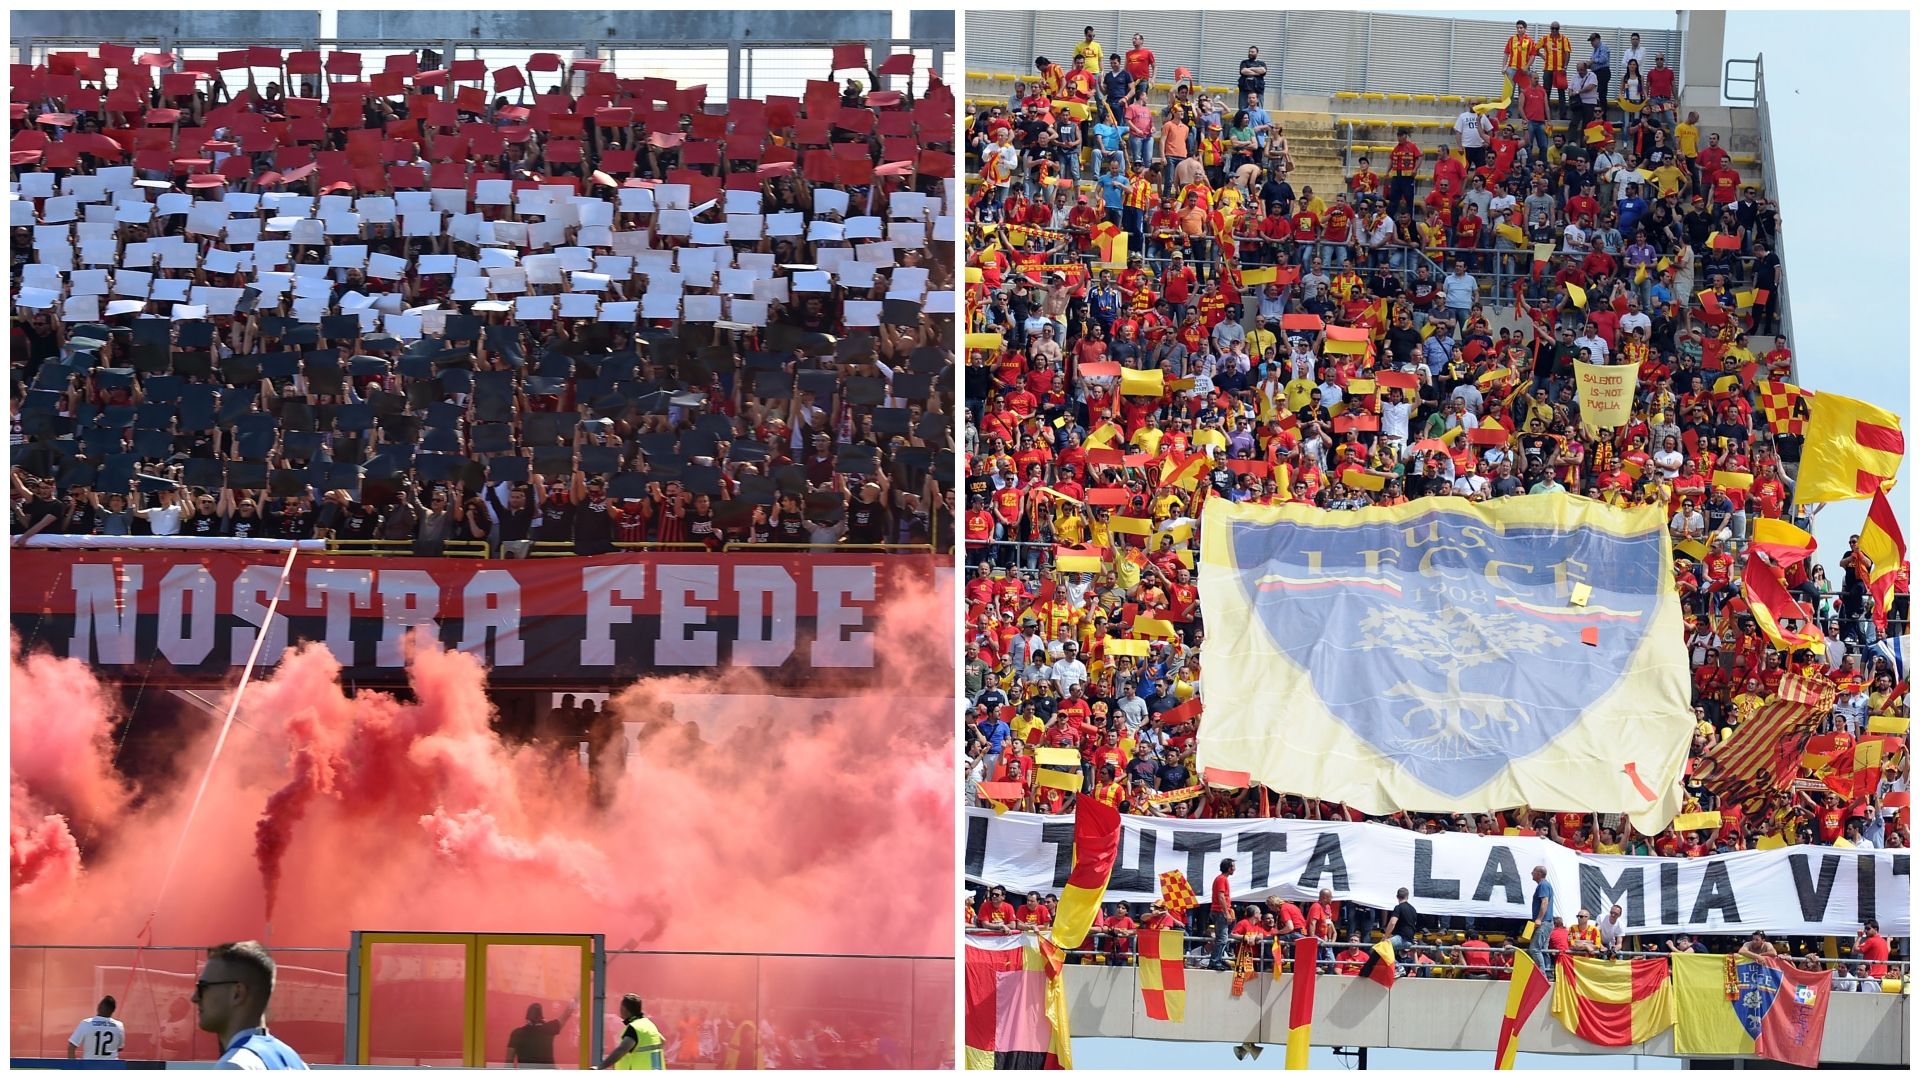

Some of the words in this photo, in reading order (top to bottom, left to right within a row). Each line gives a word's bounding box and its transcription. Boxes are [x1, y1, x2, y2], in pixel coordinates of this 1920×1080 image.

[1583, 373, 1623, 385] SALENTO
[1587, 400, 1620, 412] PUGLIA
[1300, 544, 1595, 599] LECCE
[1409, 581, 1488, 603] 1908
[69, 563, 524, 667] NOSTRA
[580, 564, 876, 667] FEDE
[1041, 822, 1350, 897] TUTTA
[1414, 838, 1525, 905] LA
[1579, 860, 1742, 927] MIA
[94, 1030, 114, 1056] 12
